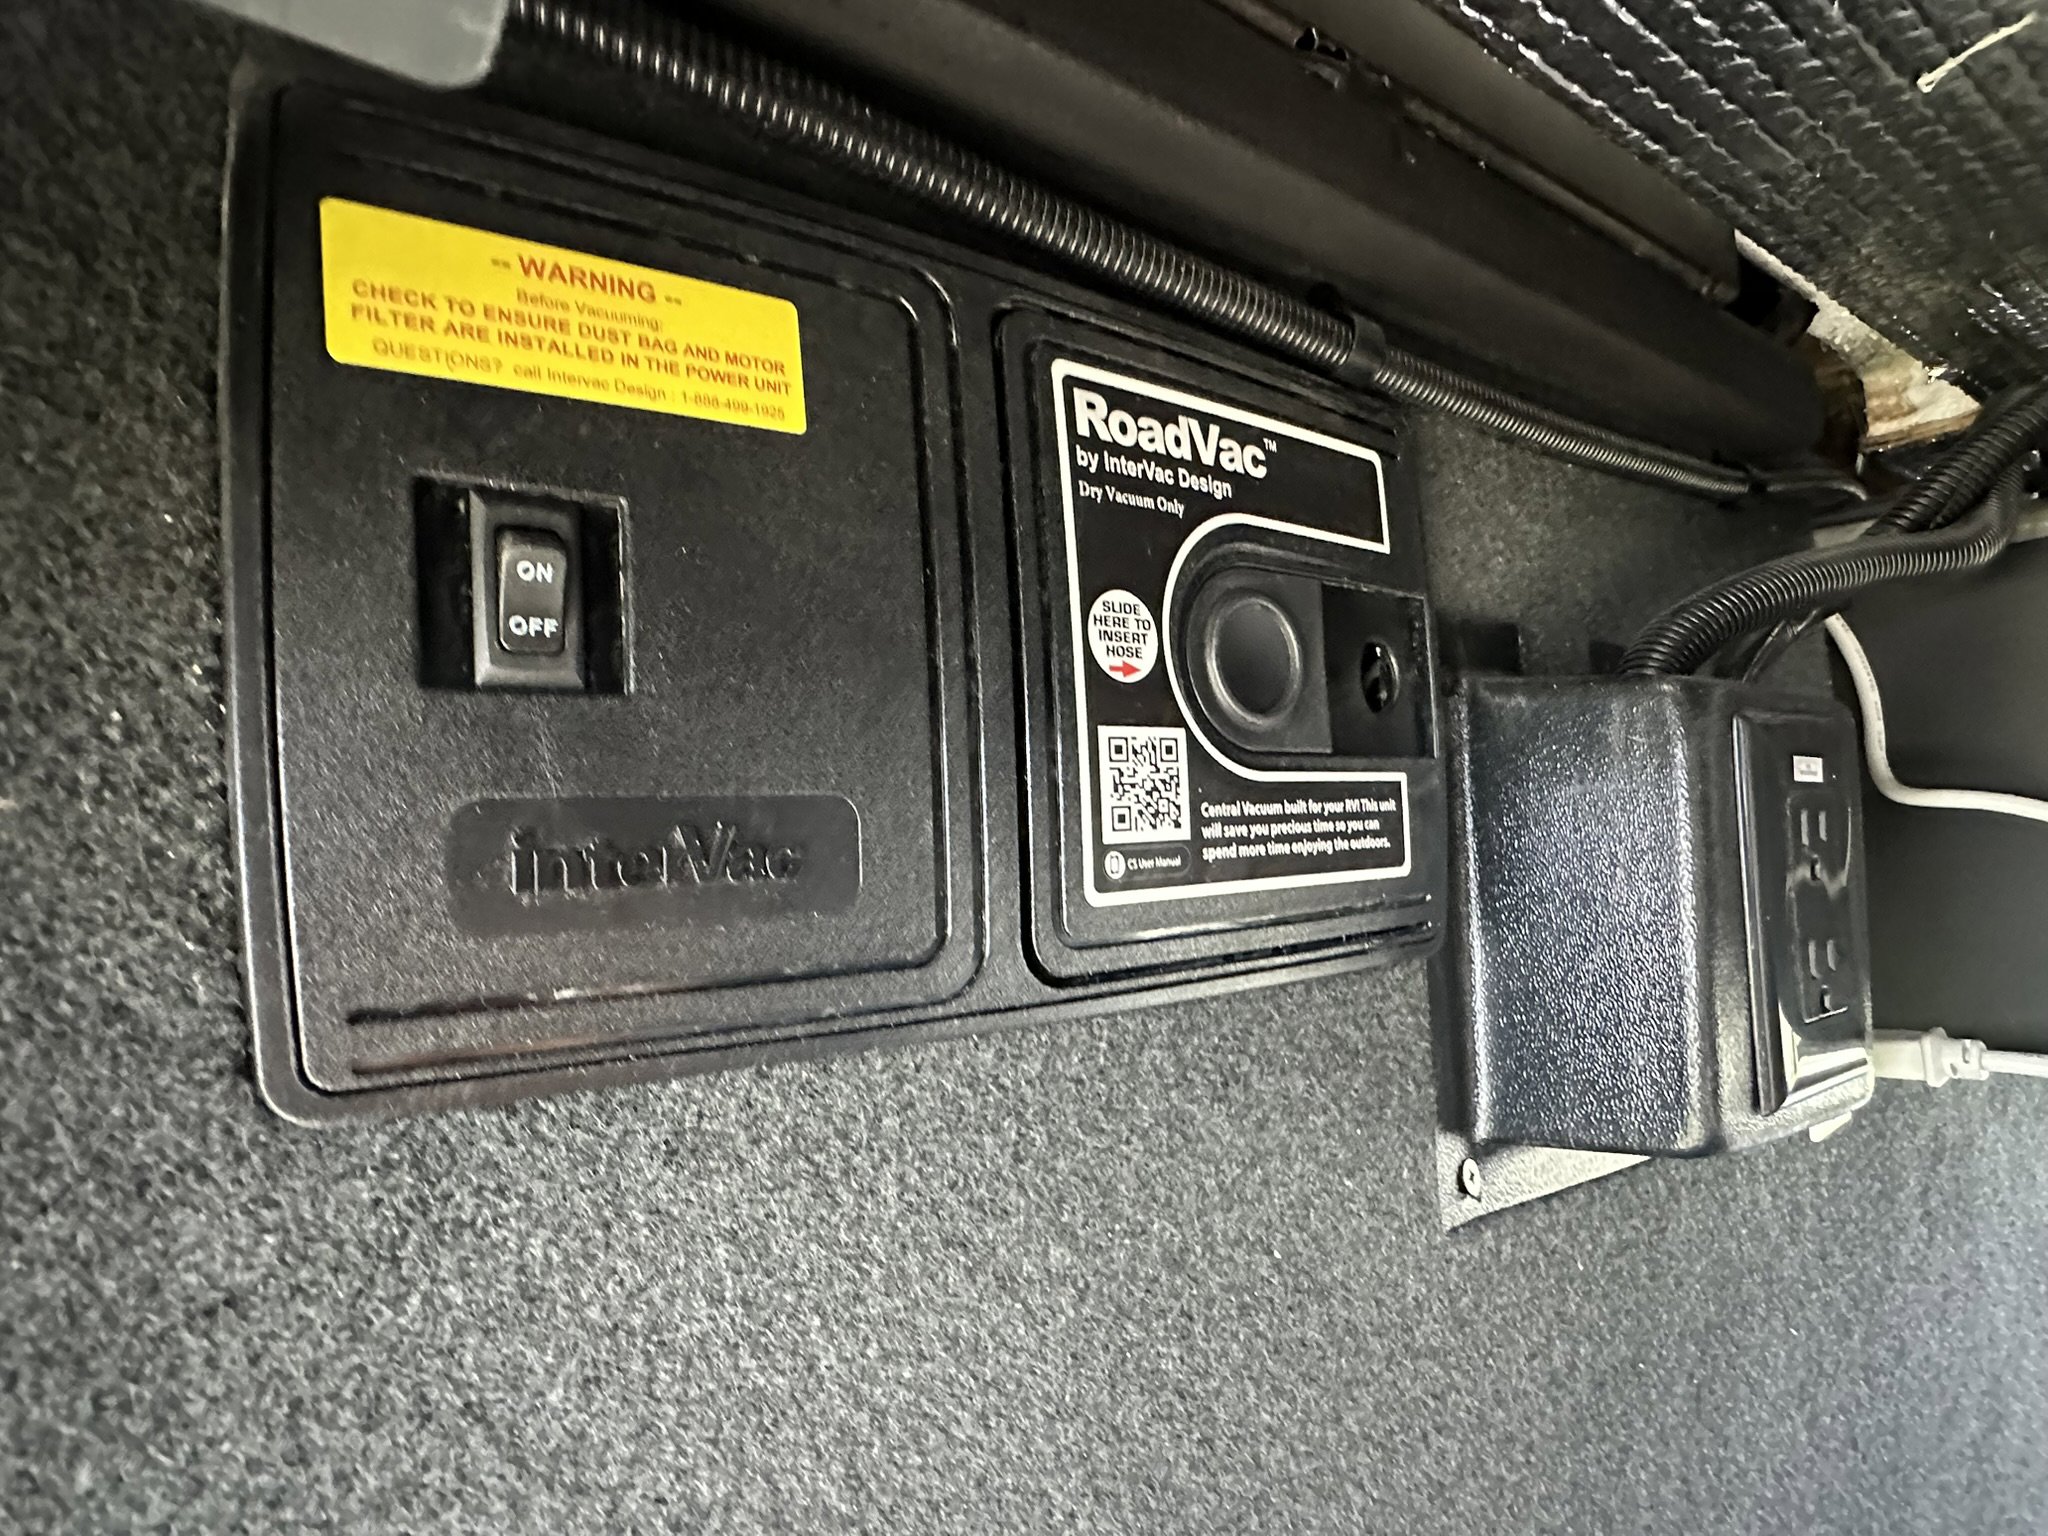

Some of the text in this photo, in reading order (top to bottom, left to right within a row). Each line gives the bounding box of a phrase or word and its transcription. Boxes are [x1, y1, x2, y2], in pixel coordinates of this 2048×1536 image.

[517, 253, 656, 303] WARNING
[517, 288, 570, 312] Before
[352, 278, 786, 377] CHECK TO ENSURE DUST BAG AND MOTOR
[351, 302, 792, 397] FILTER ARE INSTALLED IN THE POWER UNIT
[372, 337, 503, 374] QUESTIONS?
[513, 364, 542, 381] call
[548, 367, 610, 392] Intervac
[614, 378, 667, 402] Design
[1076, 444, 1232, 500] by InterVac Design
[1079, 480, 1185, 519] Dry Vacuum Only
[517, 560, 554, 584] ON
[1102, 600, 1141, 616] SLIDE
[509, 614, 559, 638] OFF
[1093, 614, 1151, 631] HERE TO
[1099, 629, 1148, 646] INSERT
[1106, 645, 1143, 660] HOSE
[1201, 800, 1241, 818] Central
[1241, 800, 1284, 816] Vacuum
[1284, 799, 1308, 815] built
[1308, 798, 1322, 814] for
[1323, 801, 1344, 817] your
[1360, 797, 1378, 812] This
[1379, 797, 1397, 812] unit
[1201, 818, 1380, 839] will save you precious time so you can
[1155, 854, 1181, 867] Manual
[1202, 835, 1391, 863] spend more time enjoying the outdoors.
